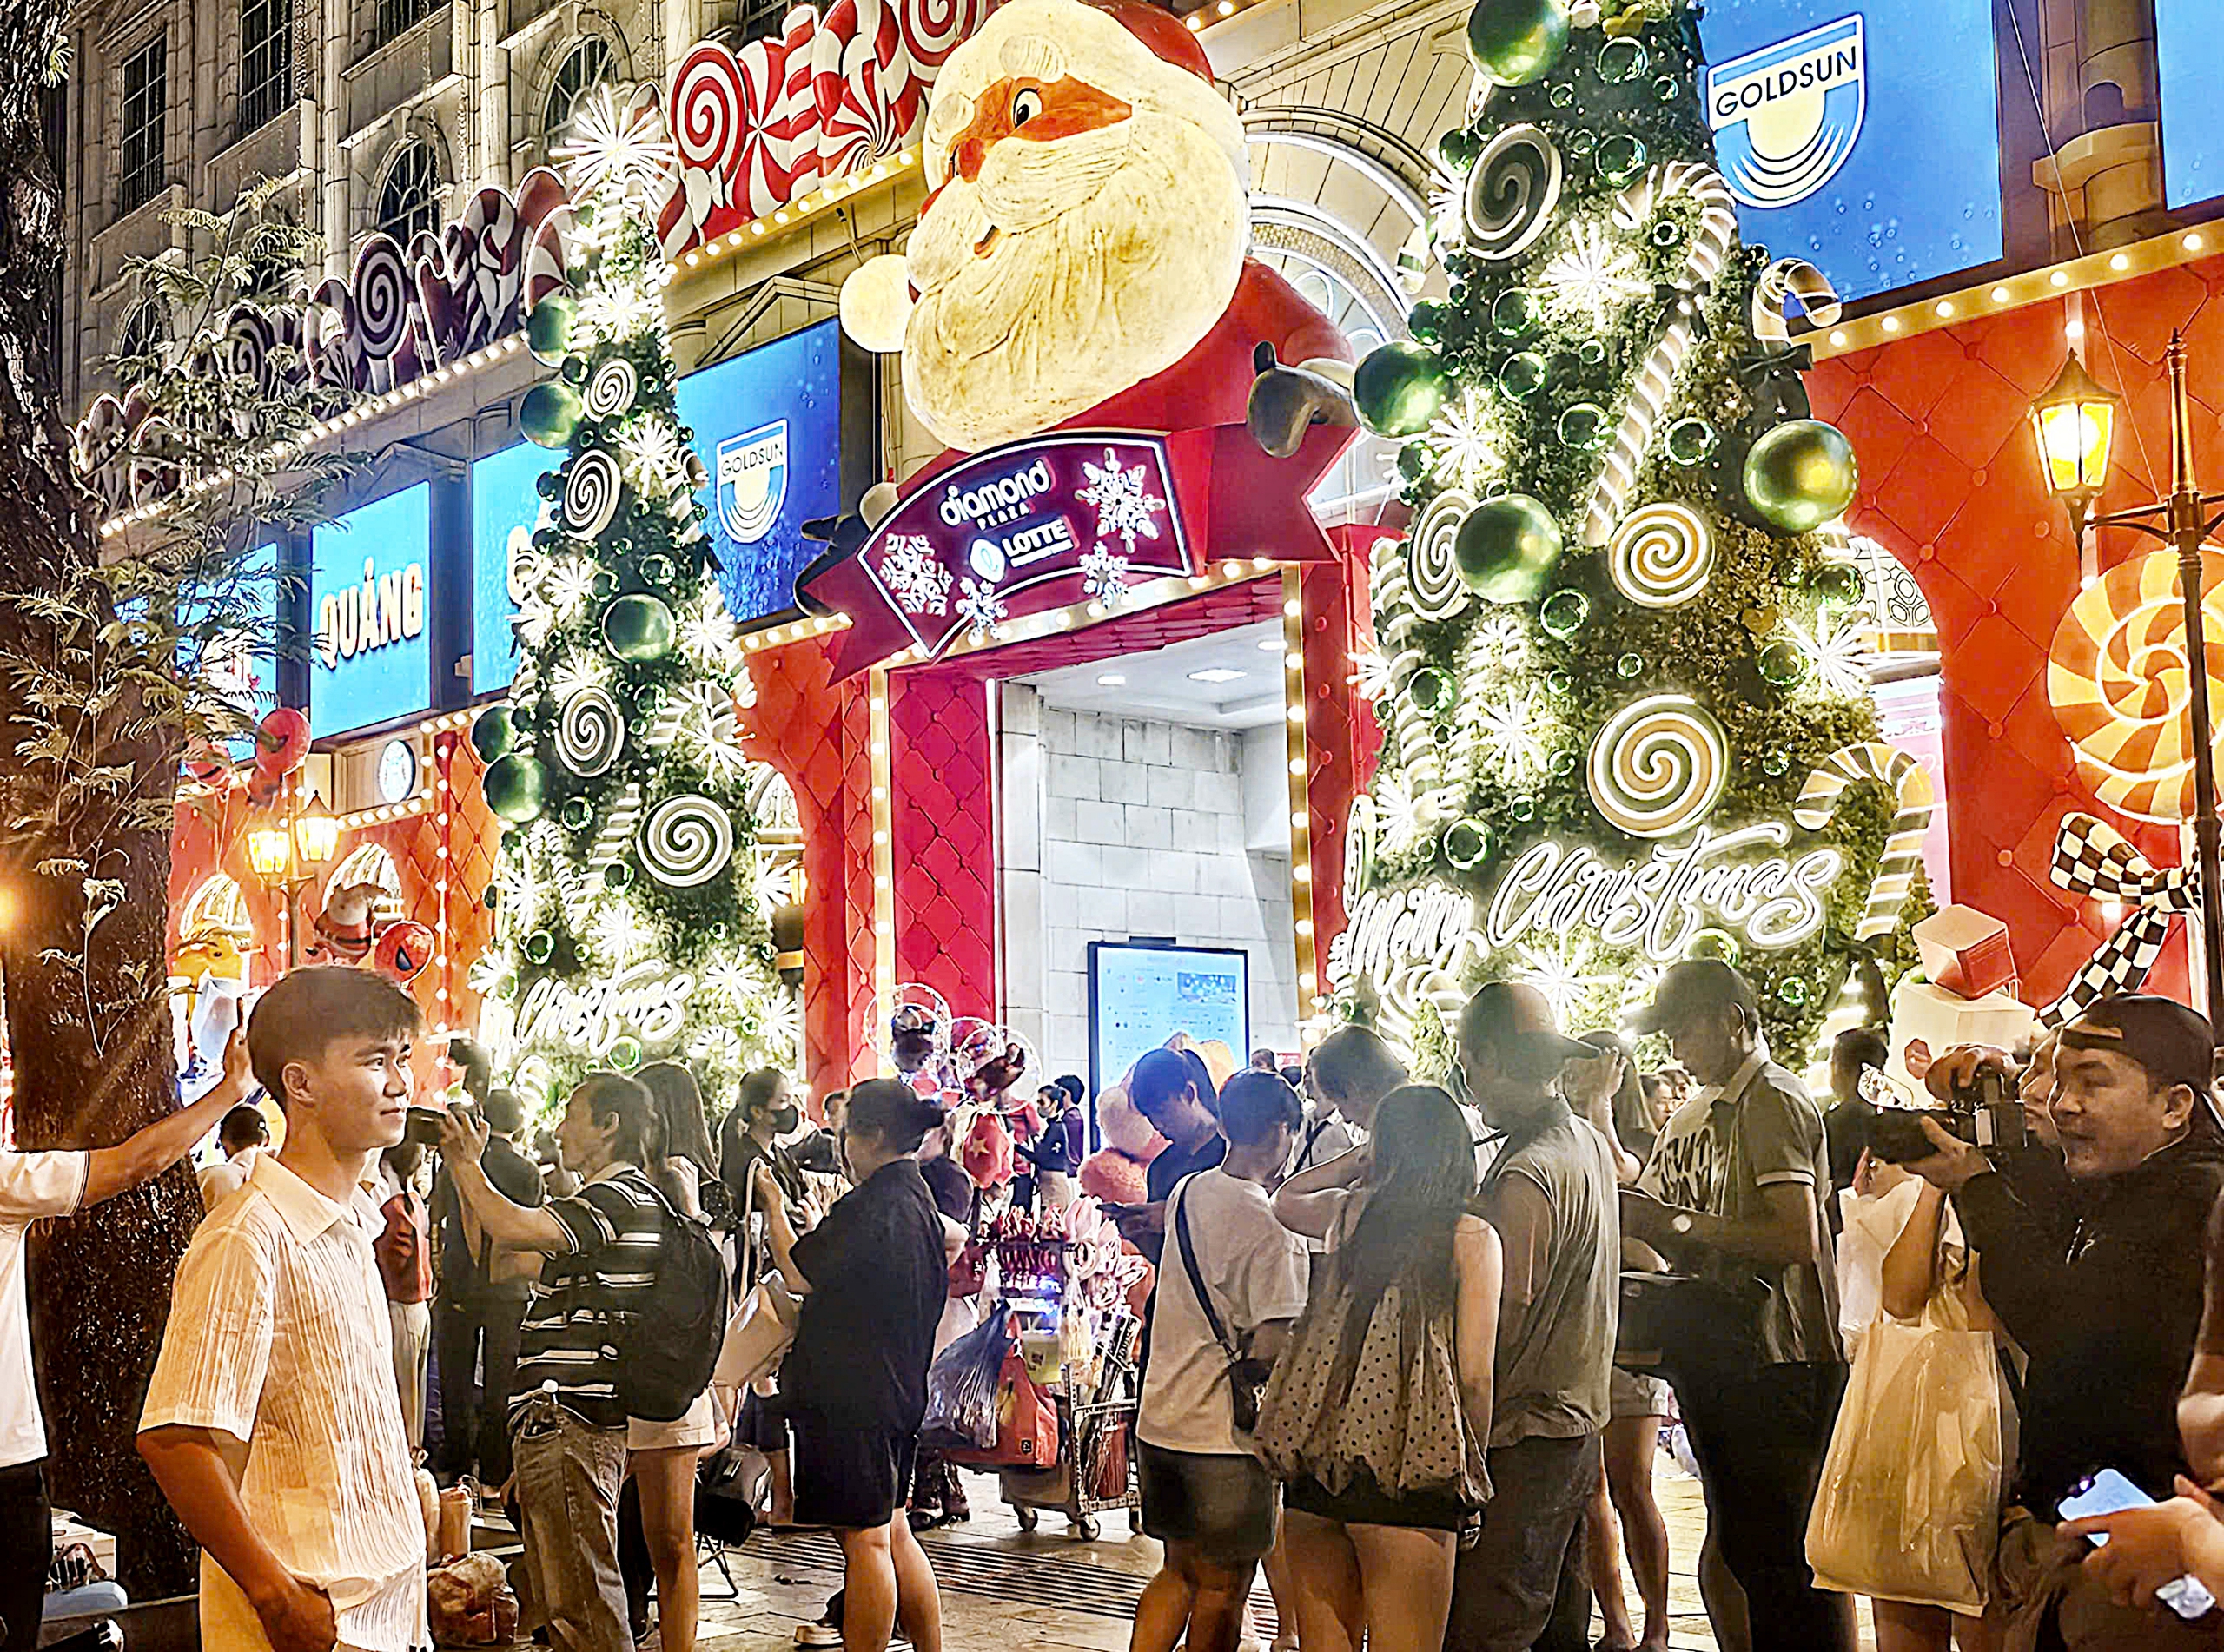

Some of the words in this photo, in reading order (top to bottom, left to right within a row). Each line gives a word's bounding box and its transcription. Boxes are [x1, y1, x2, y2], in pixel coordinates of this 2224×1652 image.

[1715, 45, 1857, 117] GOLDSUN
[720, 440, 784, 478] GOLDSUN
[939, 459, 1050, 526] diamond
[976, 501, 1030, 532] PLAZA
[1001, 519, 1069, 558] LOTTE
[1486, 823, 1840, 960] Christmas
[516, 958, 695, 1056] Christmas
